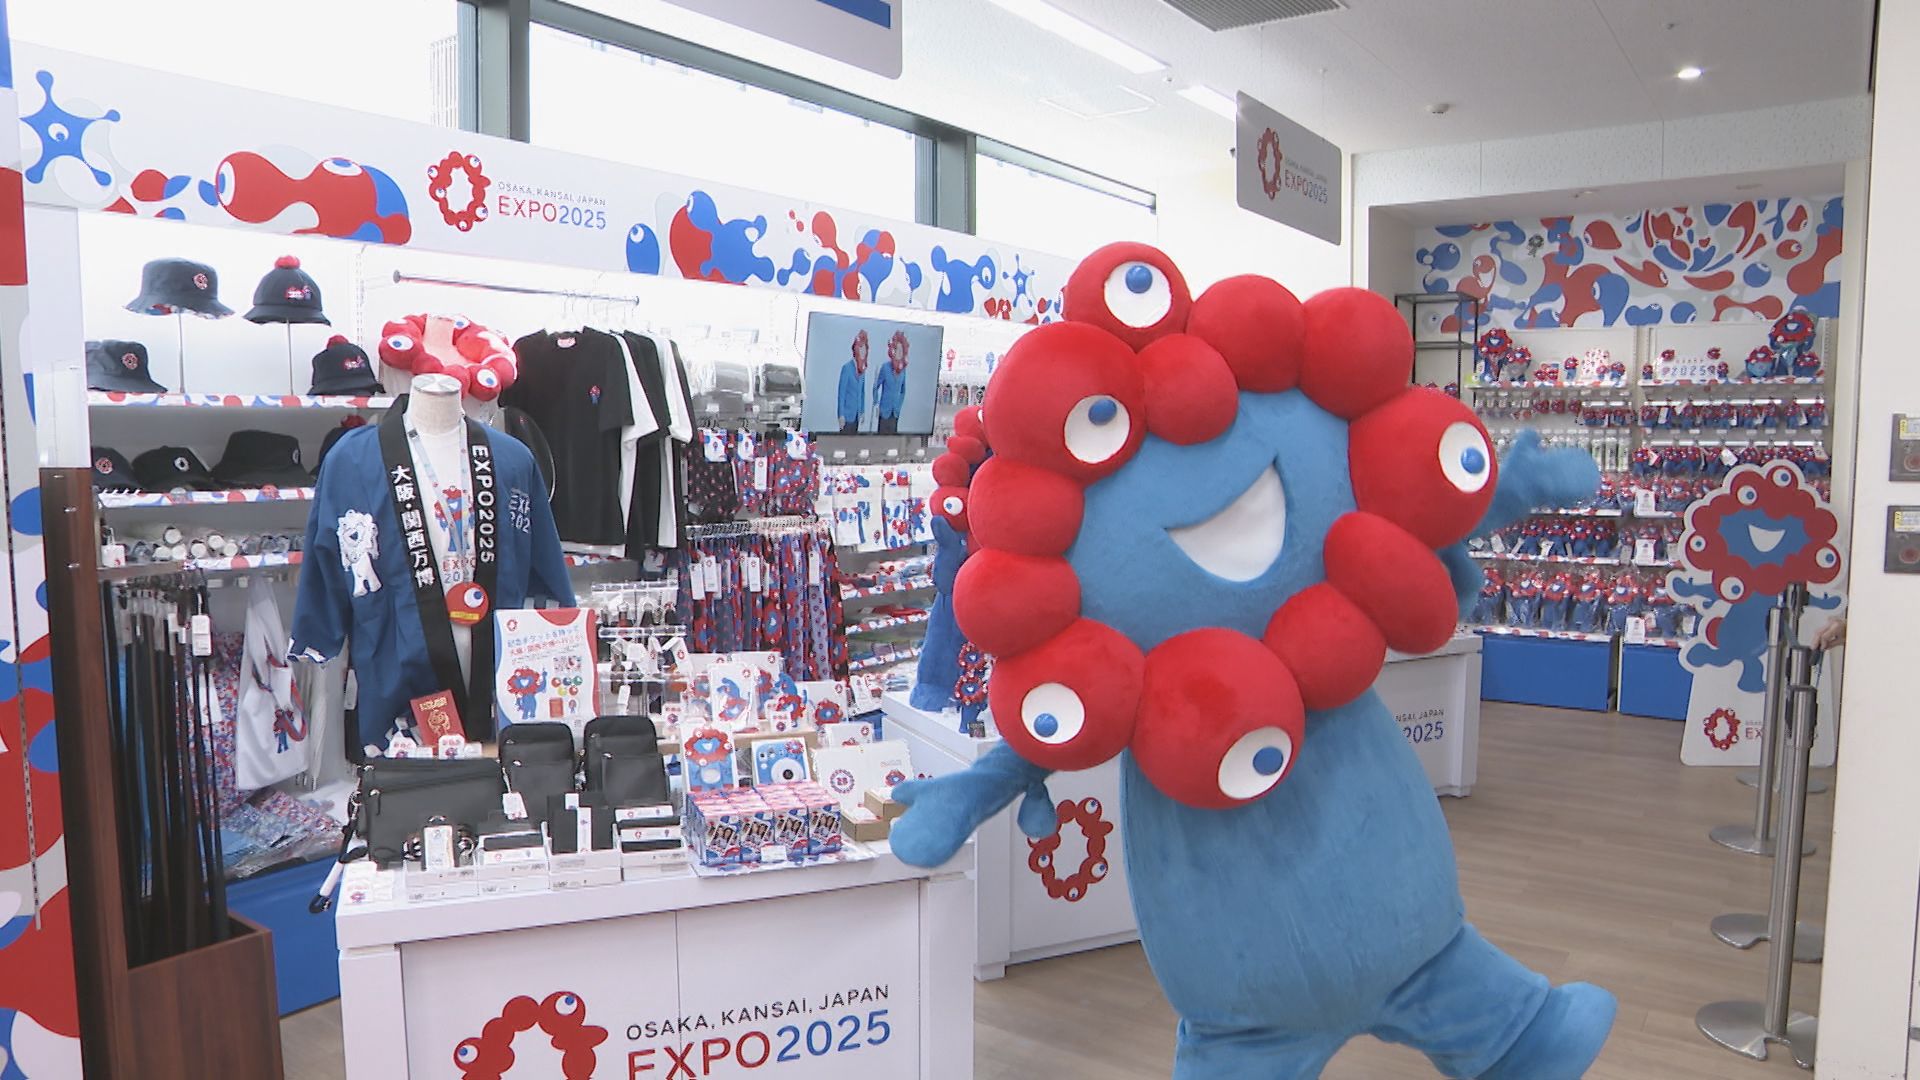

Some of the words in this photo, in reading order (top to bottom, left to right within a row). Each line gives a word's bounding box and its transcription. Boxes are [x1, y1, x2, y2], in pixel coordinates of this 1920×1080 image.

[498, 181, 534, 195] OSAKA,
[576, 195, 606, 206] JAPAN
[1284, 169, 1328, 204] EXPO2025
[498, 195, 606, 230] EXPO2025
[471, 445, 495, 563] EXPO2025
[391, 465, 436, 588] 大阪・関西万博
[1418, 708, 1445, 720] JAPAN
[1402, 721, 1444, 744] 2025
[626, 1014, 715, 1040] OSAKA,
[721, 998, 812, 1026] KANSAI,
[819, 984, 890, 1010] JAPAN
[627, 1009, 891, 1080] EXPO2025
